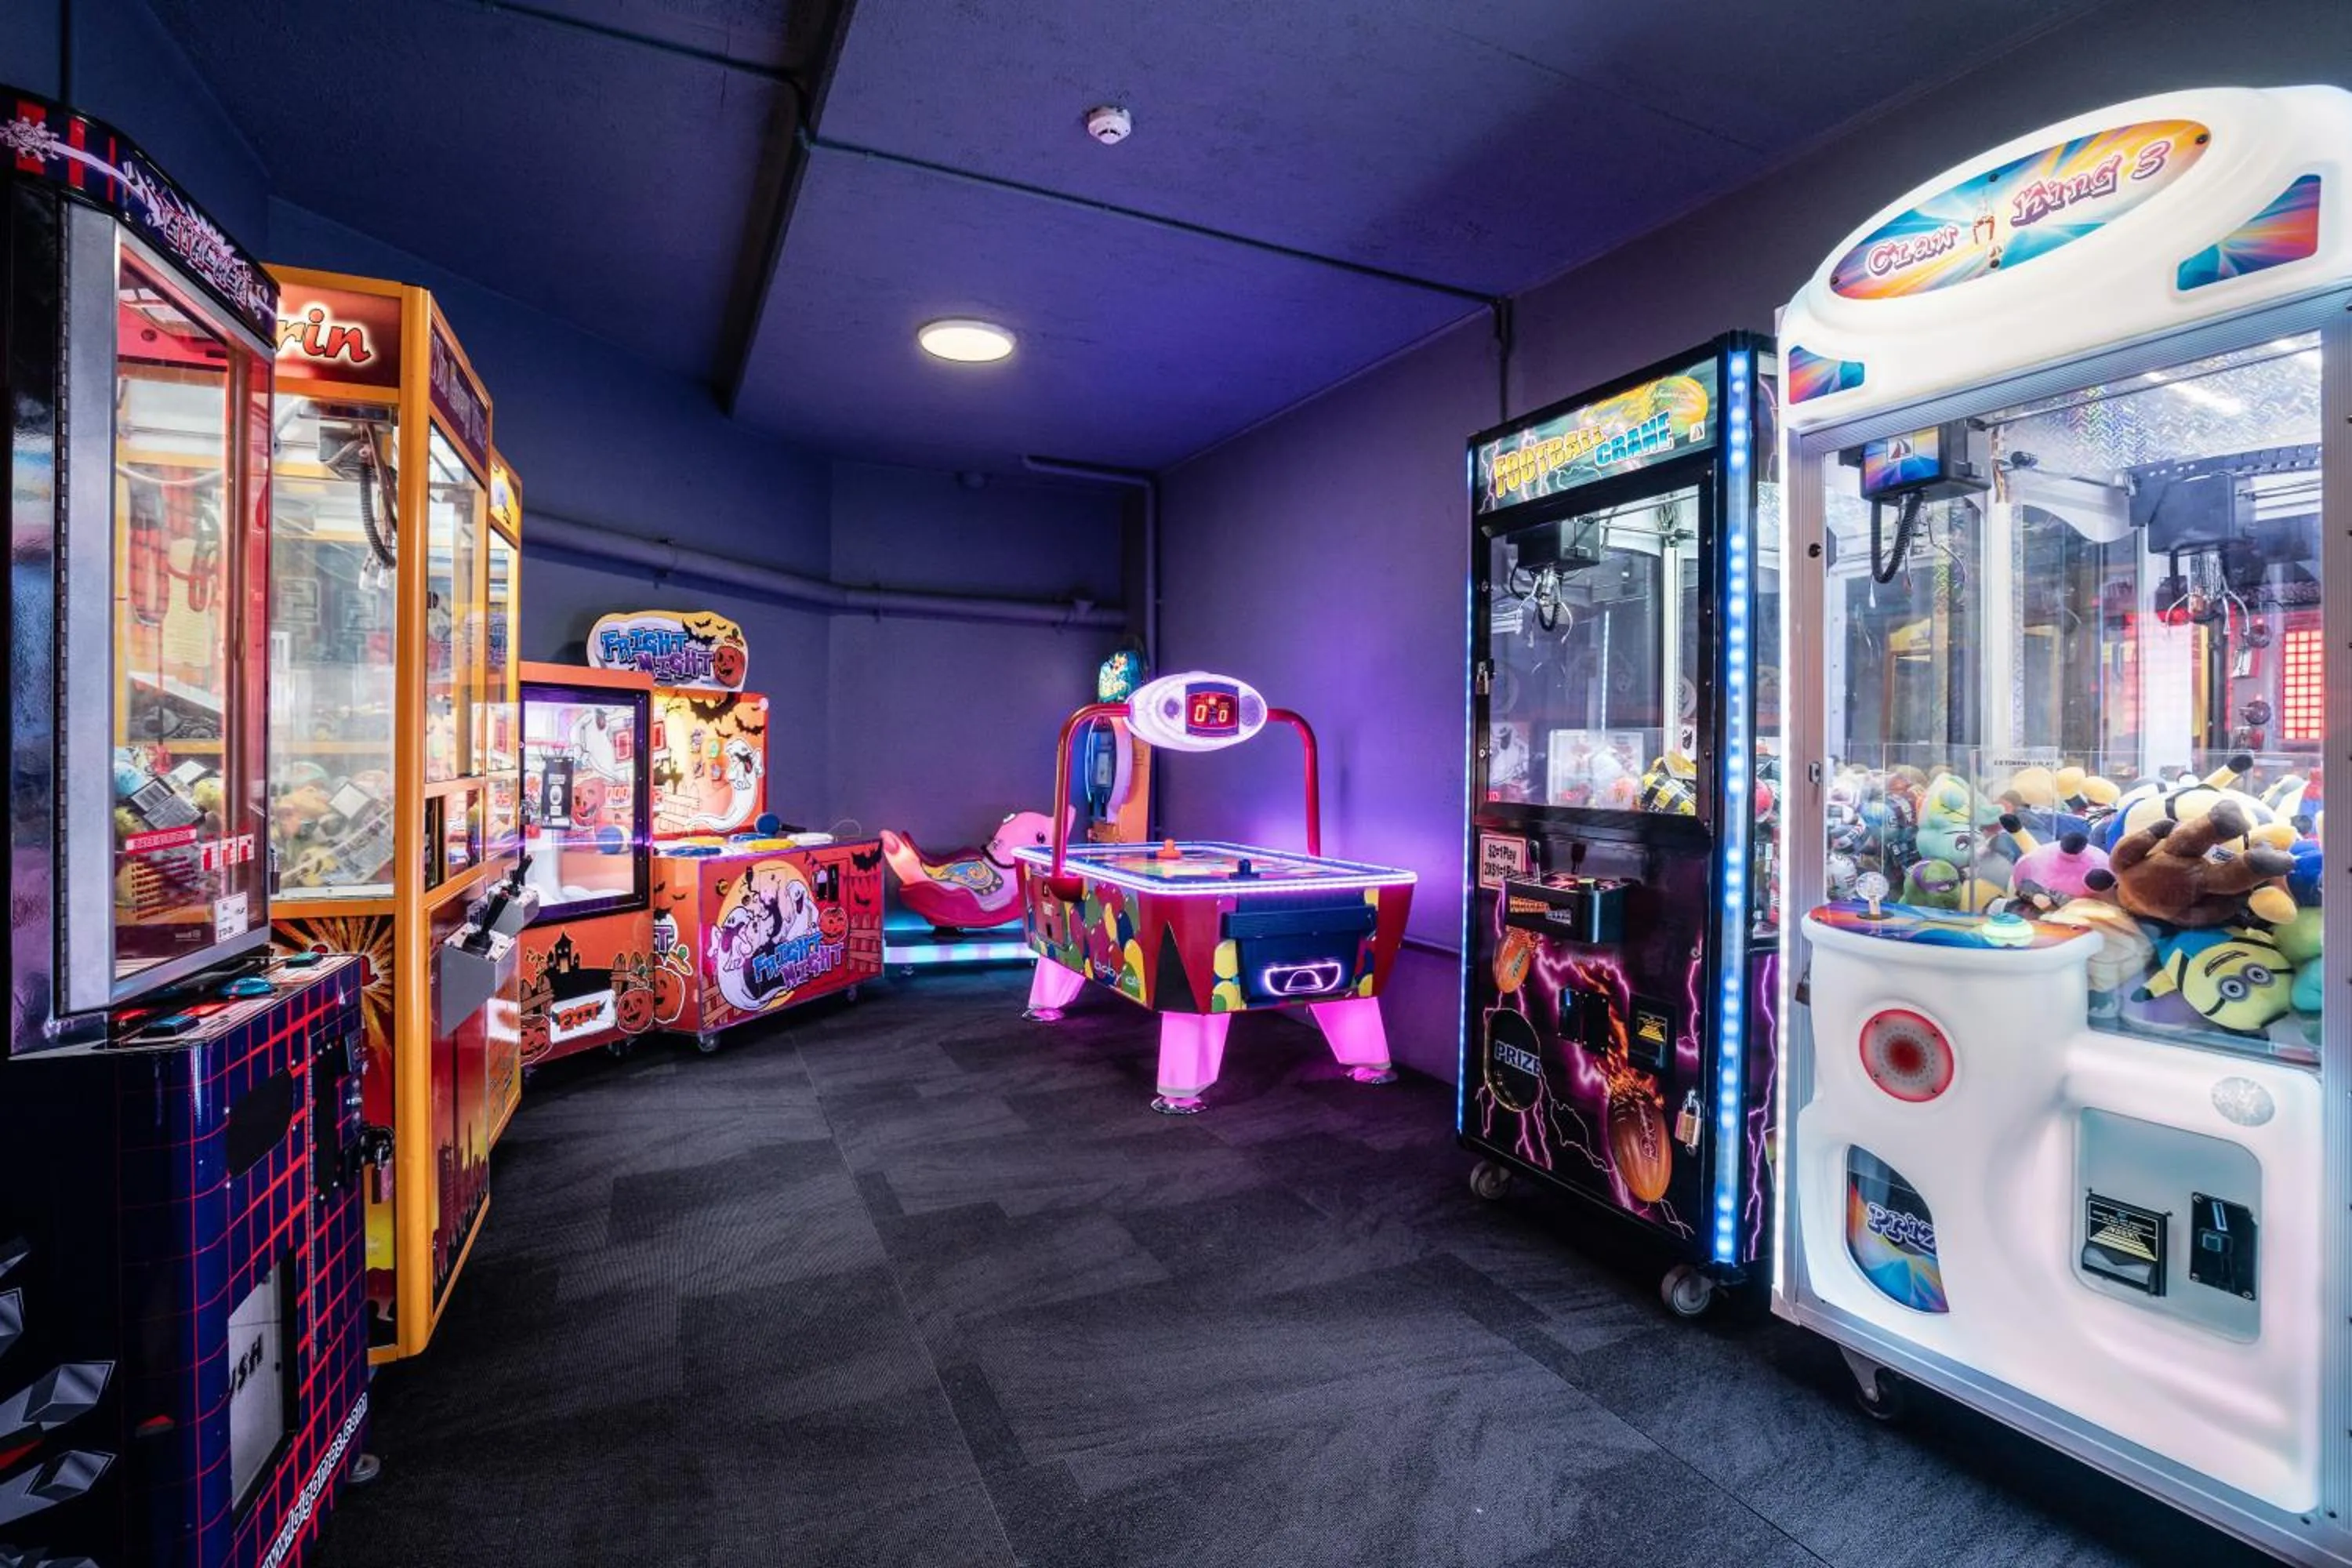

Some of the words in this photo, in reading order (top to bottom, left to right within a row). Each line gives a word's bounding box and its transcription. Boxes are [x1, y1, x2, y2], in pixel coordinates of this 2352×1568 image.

[2132, 140, 2172, 181] 3
[1493, 424, 1607, 499] FOOTBALL
[1594, 408, 1674, 467] CRANE
[601, 628, 689, 663] FRIGHT
[632, 647, 716, 681] NIGHT
[752, 931, 822, 983] FRIGHT
[780, 942, 844, 989] NIGHT
[1494, 1040, 1541, 1078] PRIZE
